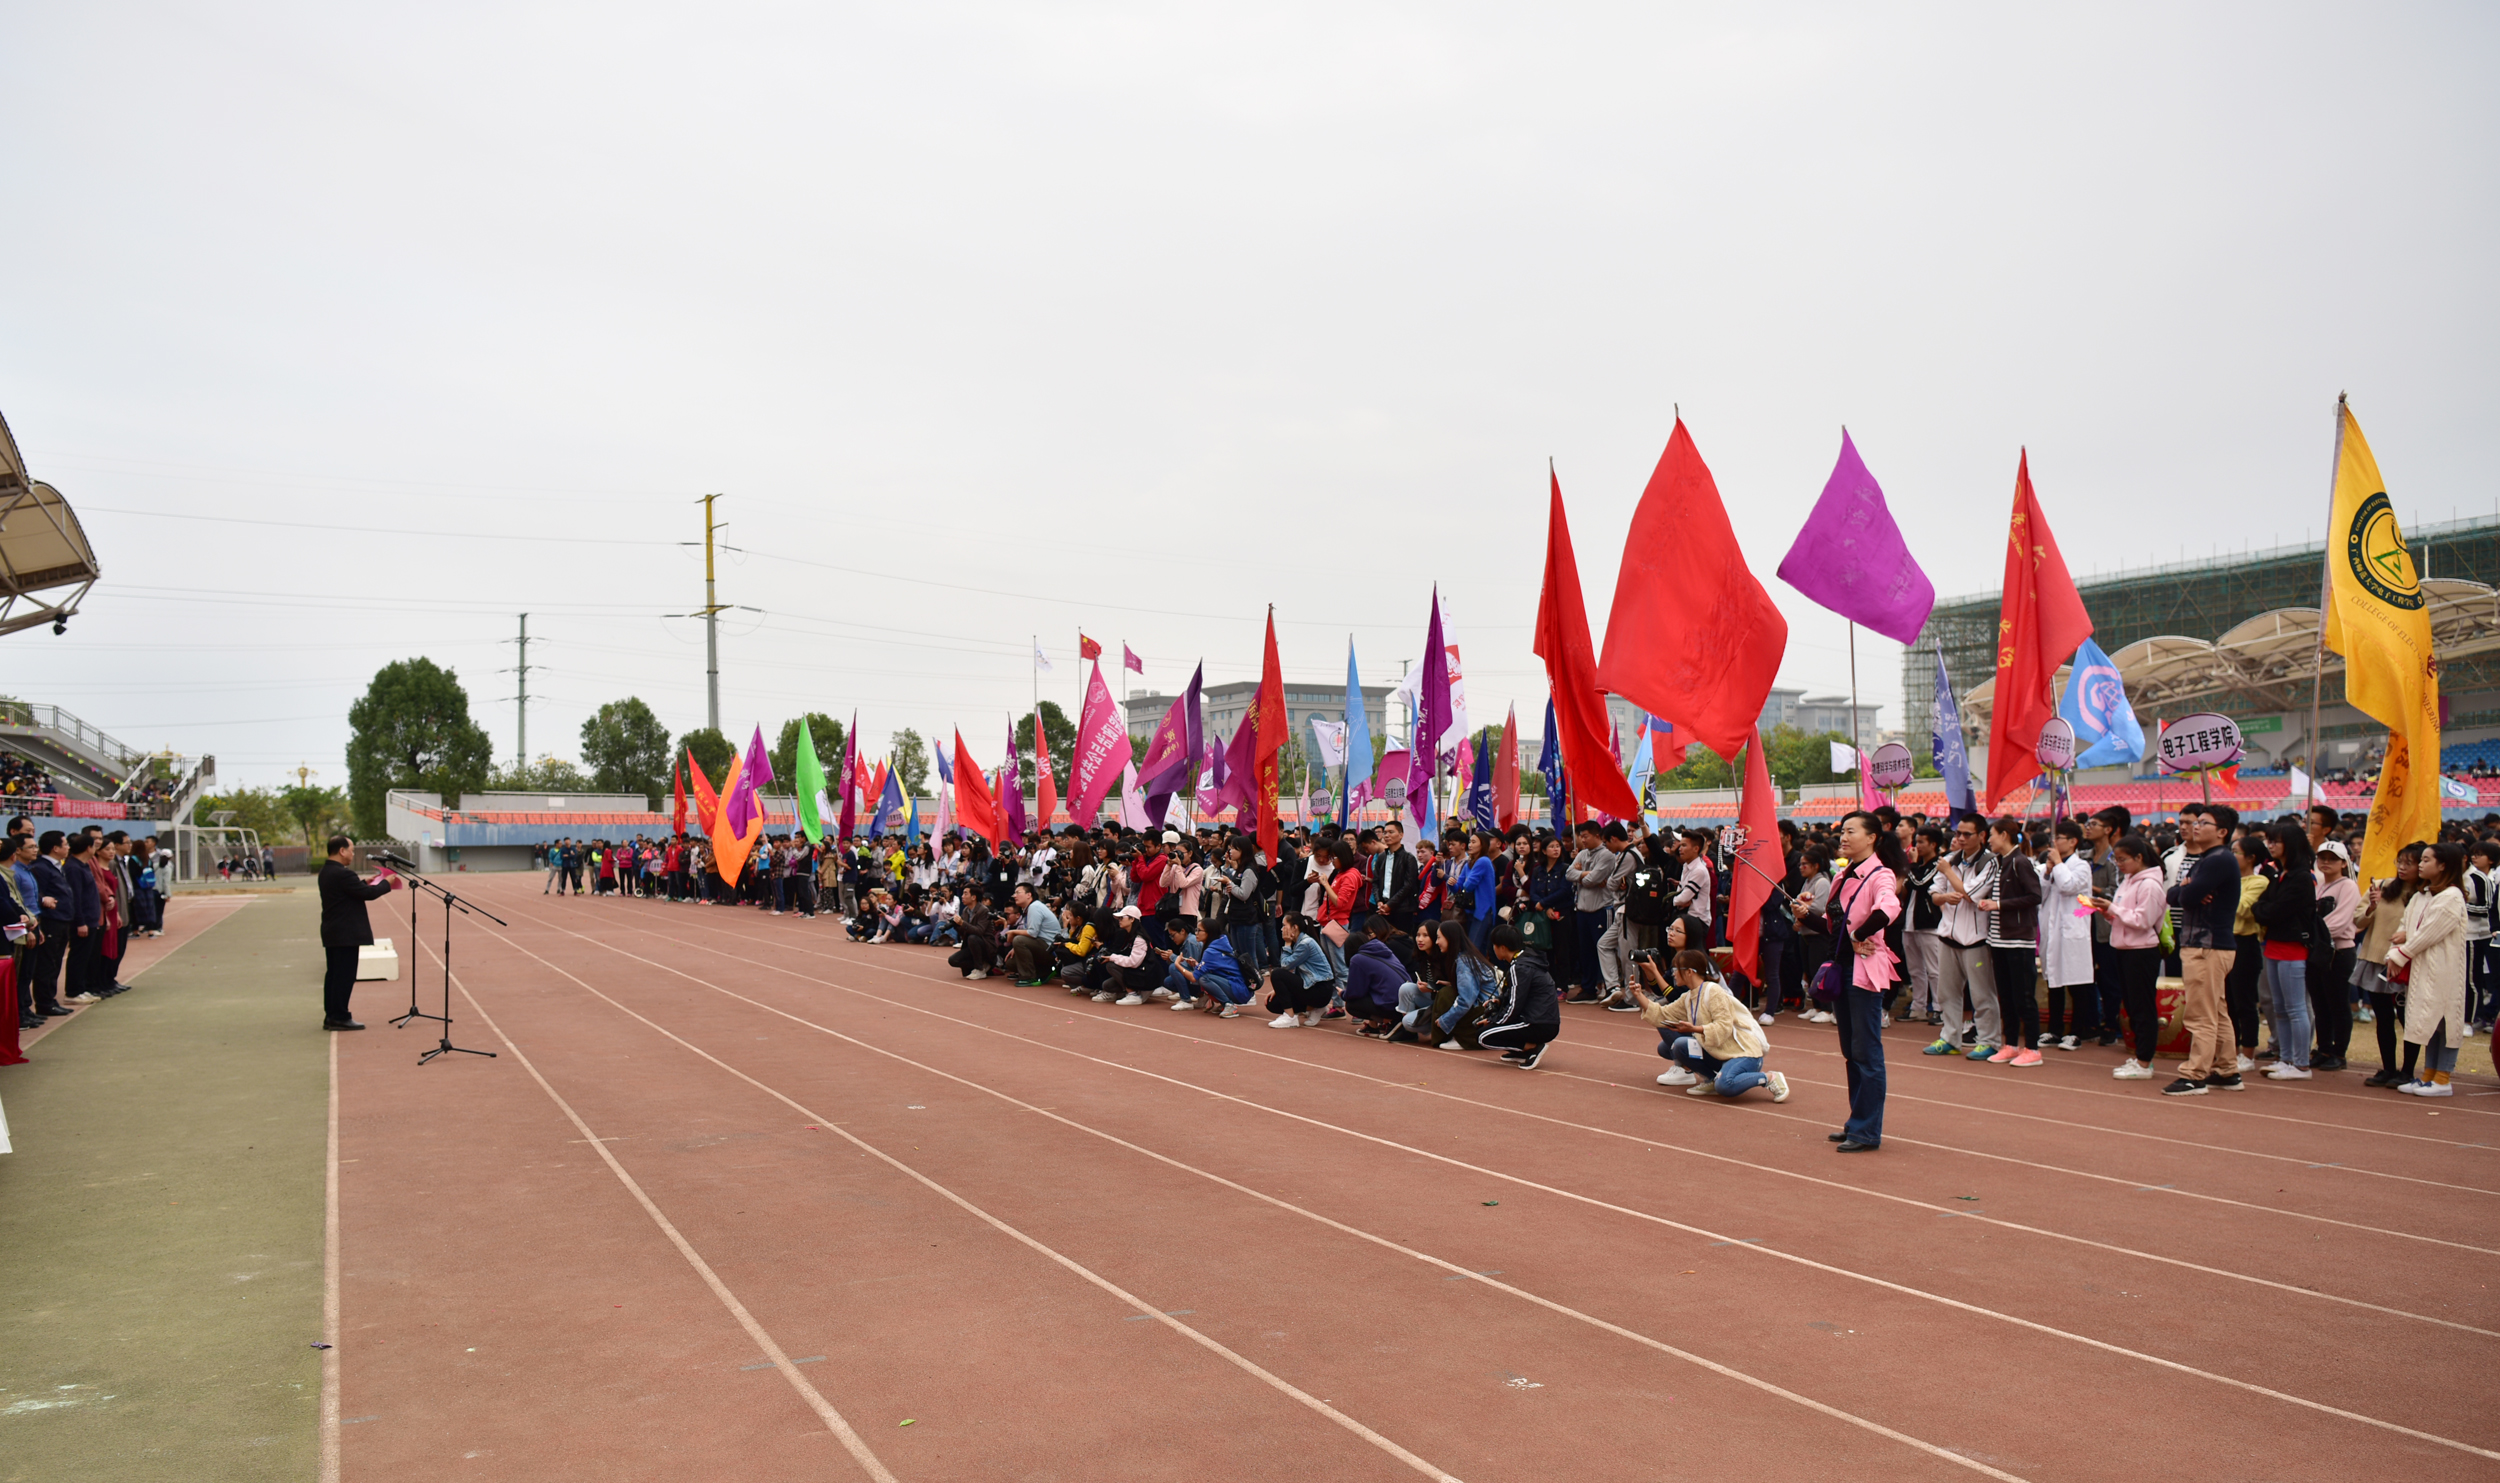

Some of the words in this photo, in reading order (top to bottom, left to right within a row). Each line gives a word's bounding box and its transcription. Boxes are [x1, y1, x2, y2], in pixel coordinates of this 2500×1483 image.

[2351, 595, 2389, 623] COLLEGE
[2387, 620, 2400, 632] OF
[2162, 725, 2236, 759] 电子工程学院
